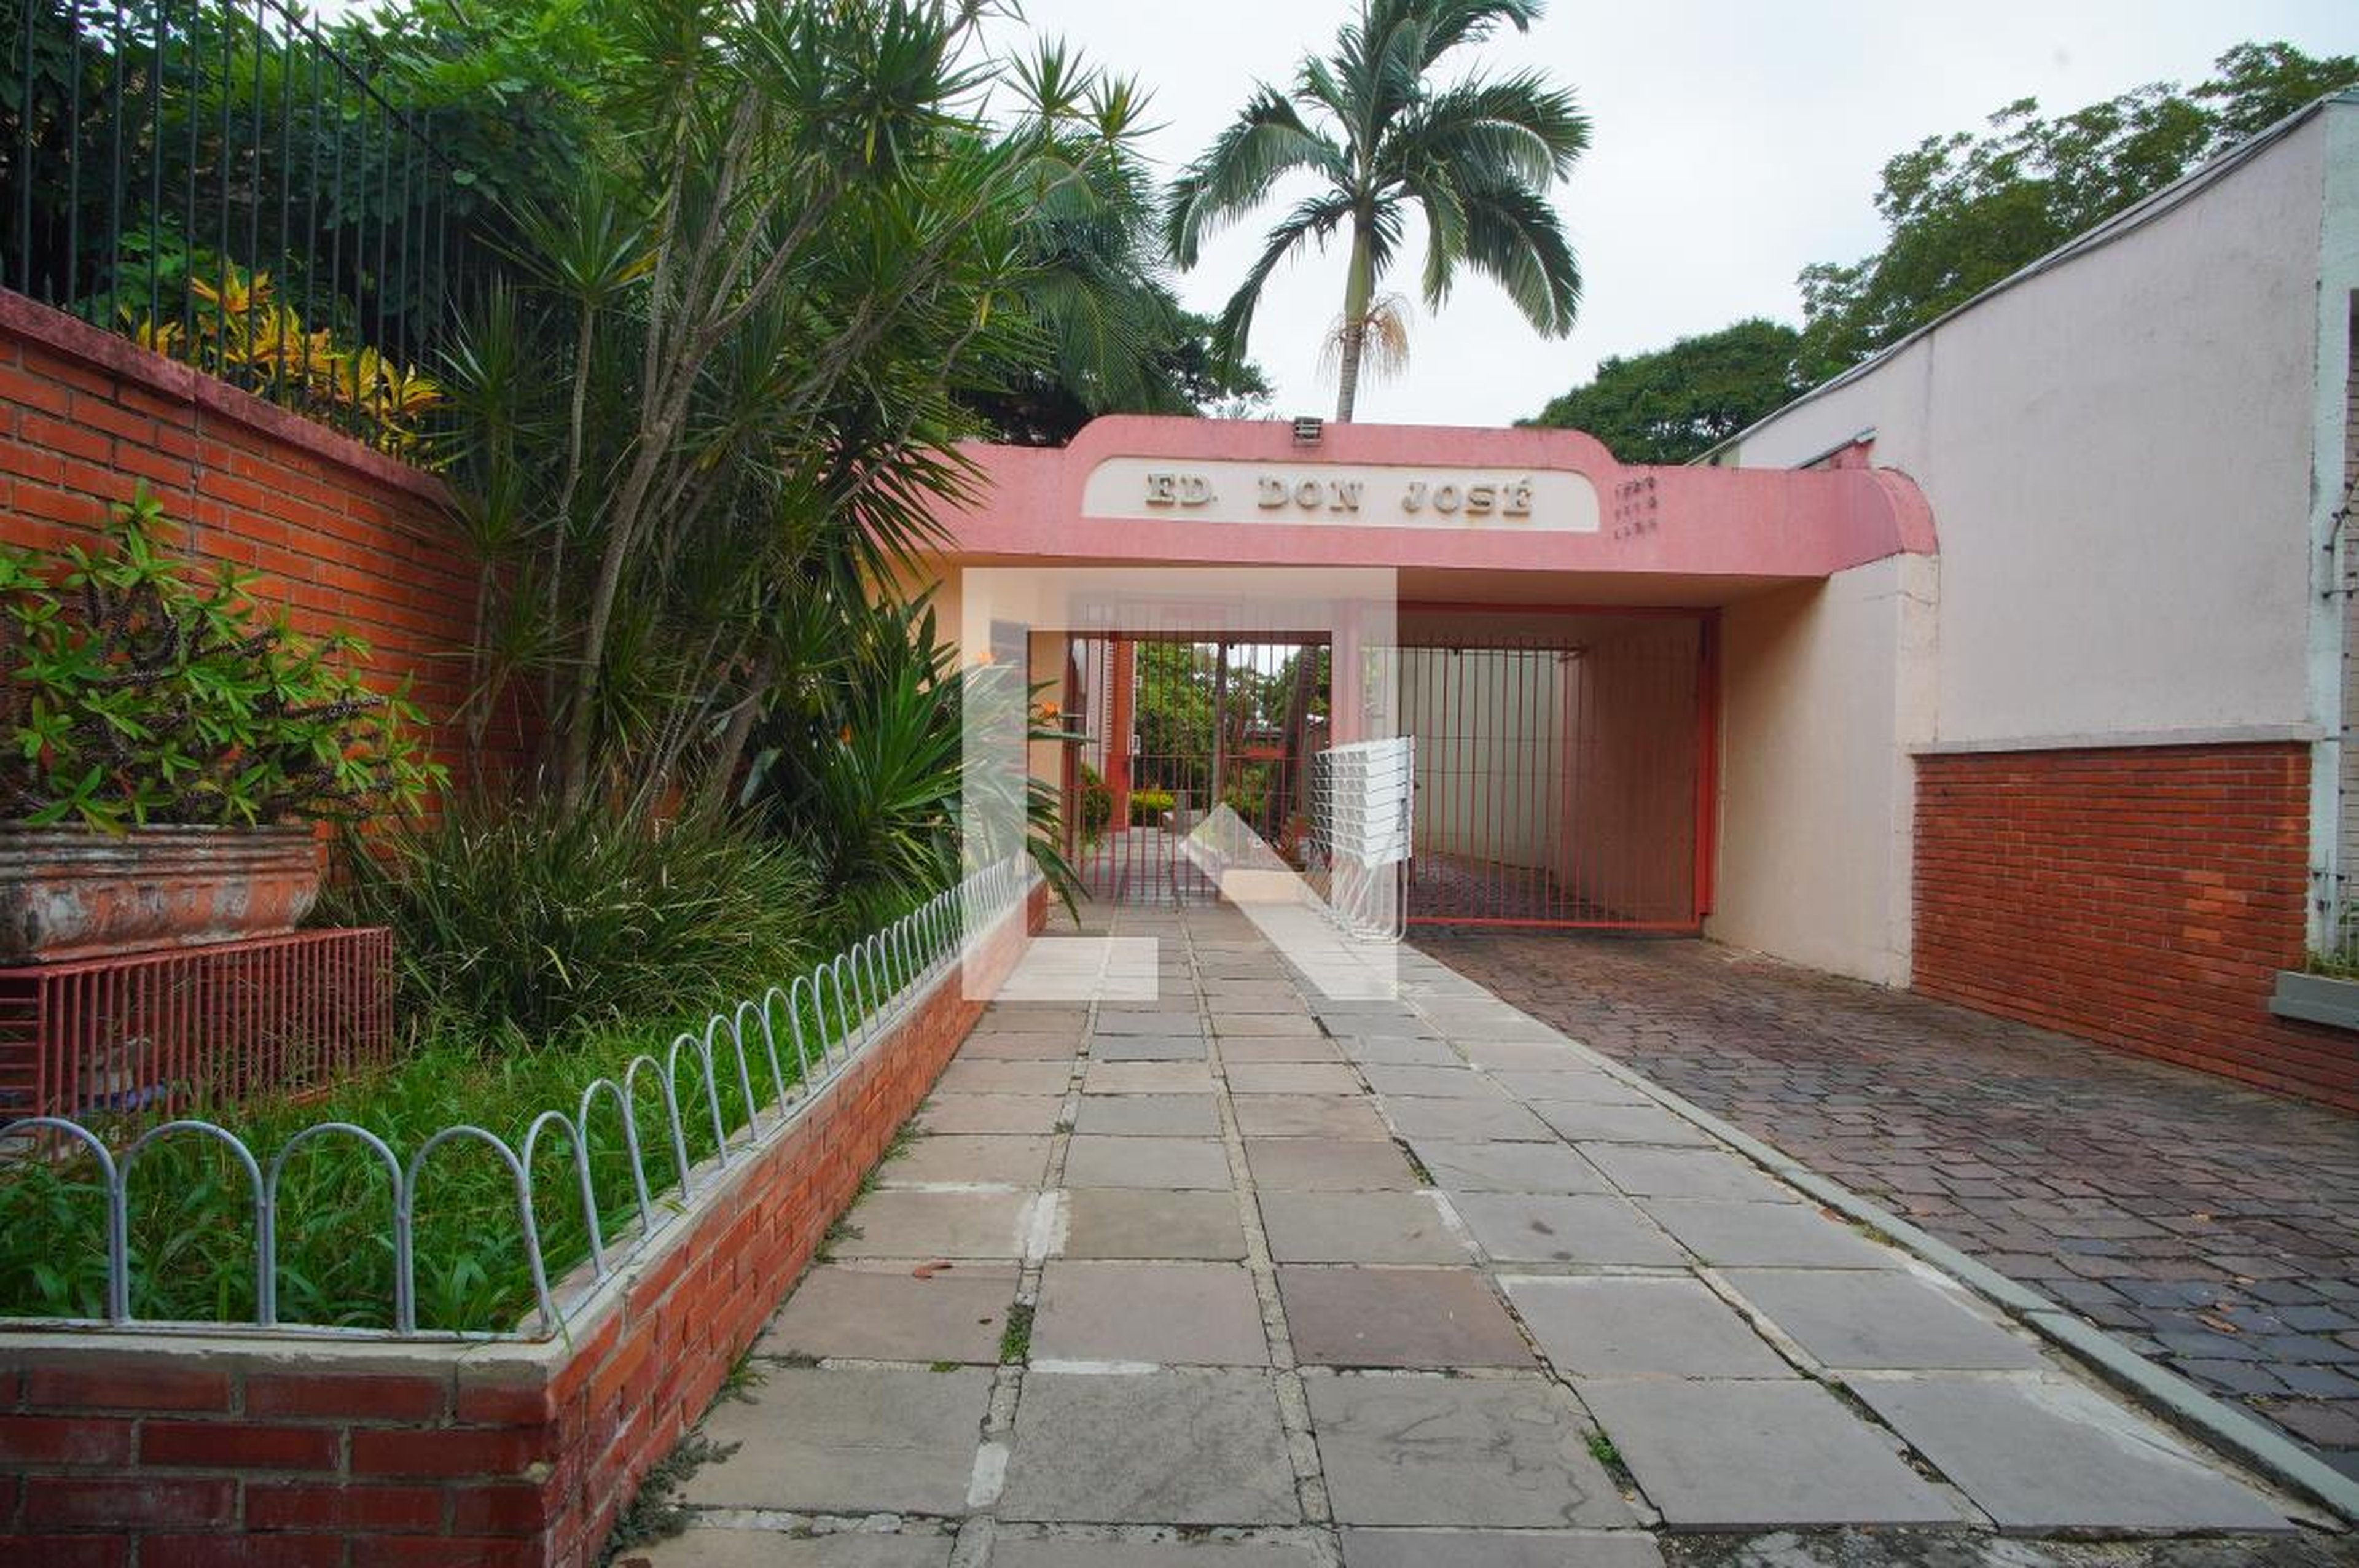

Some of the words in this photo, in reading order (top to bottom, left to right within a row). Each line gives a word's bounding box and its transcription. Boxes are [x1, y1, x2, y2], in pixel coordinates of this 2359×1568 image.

[1145, 472, 1218, 507] ED.
[1258, 475, 1362, 512] DON
[1402, 475, 1532, 517] JOSÉ
